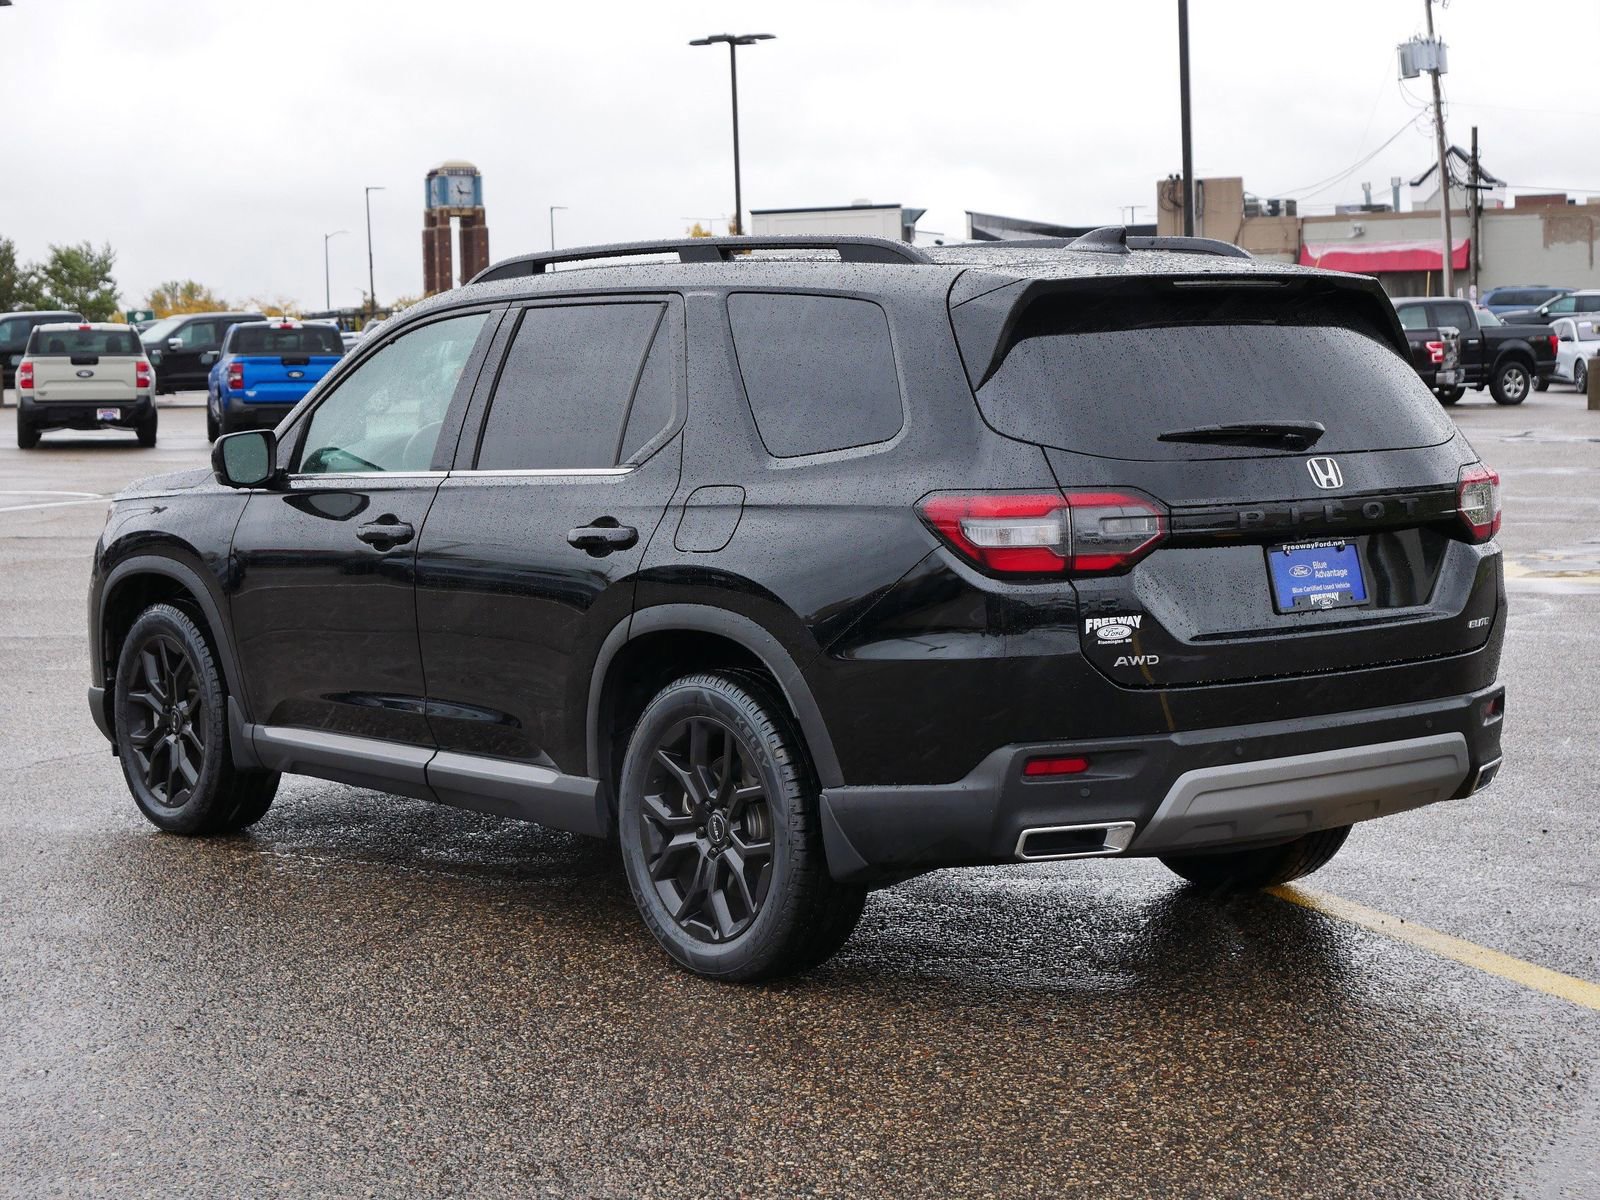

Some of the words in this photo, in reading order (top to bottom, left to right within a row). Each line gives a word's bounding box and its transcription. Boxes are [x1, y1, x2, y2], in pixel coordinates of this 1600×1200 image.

[1238, 497, 1420, 529] PILOT
[1282, 540, 1346, 551] FreewayFord.net
[1312, 561, 1328, 569] Blue
[1314, 569, 1348, 578] Advantage
[1310, 592, 1340, 605] FREEWAY
[1085, 615, 1142, 635] FREEWAY
[1103, 629, 1125, 637] Ford
[1114, 655, 1160, 667] AWD
[735, 716, 770, 768] KELLY
